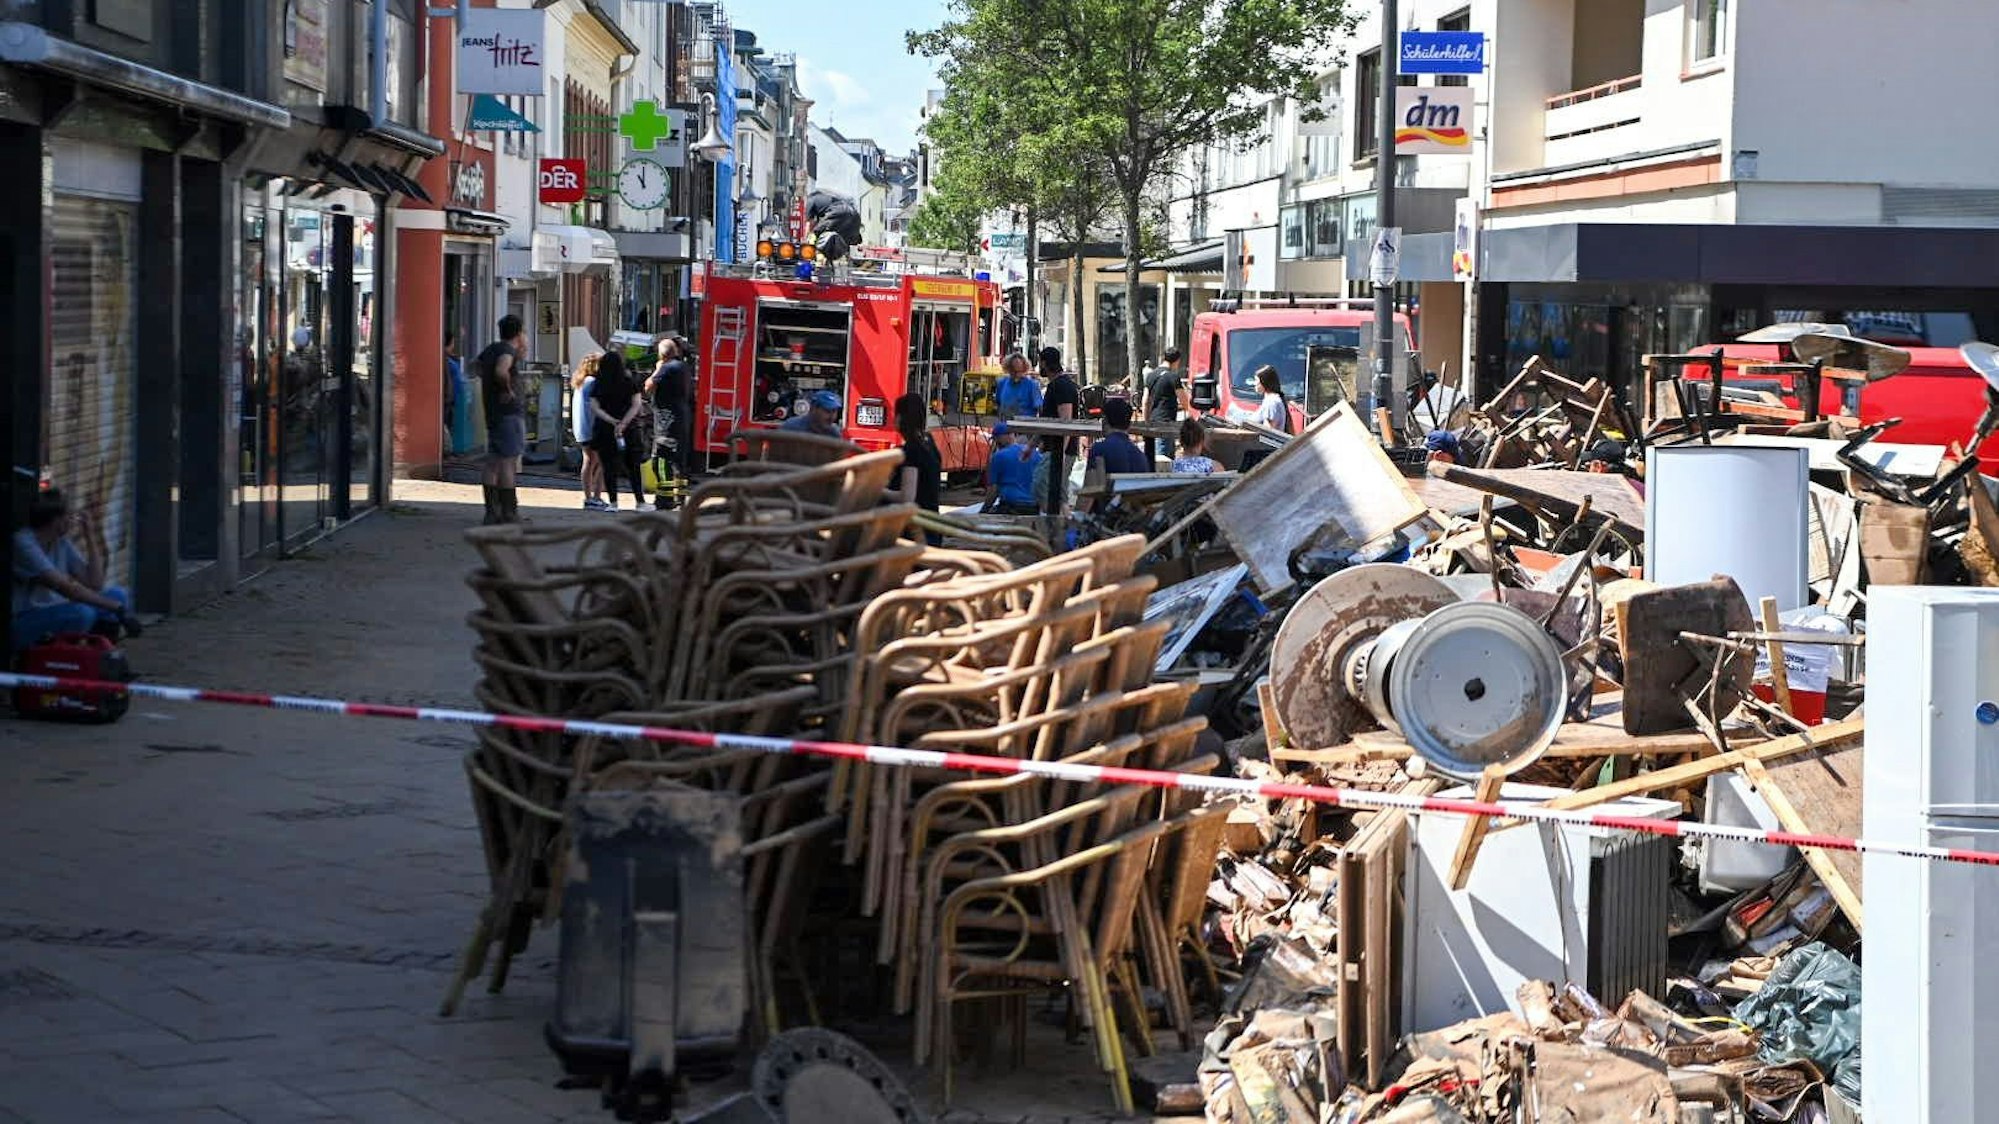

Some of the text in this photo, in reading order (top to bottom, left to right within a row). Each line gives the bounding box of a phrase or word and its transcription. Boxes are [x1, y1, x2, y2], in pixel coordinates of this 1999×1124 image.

[462, 33, 540, 68] JEANS fritz
[1402, 43, 1482, 62] Schülerhilfe!
[1406, 95, 1460, 127] dm
[540, 171, 579, 189] DER
